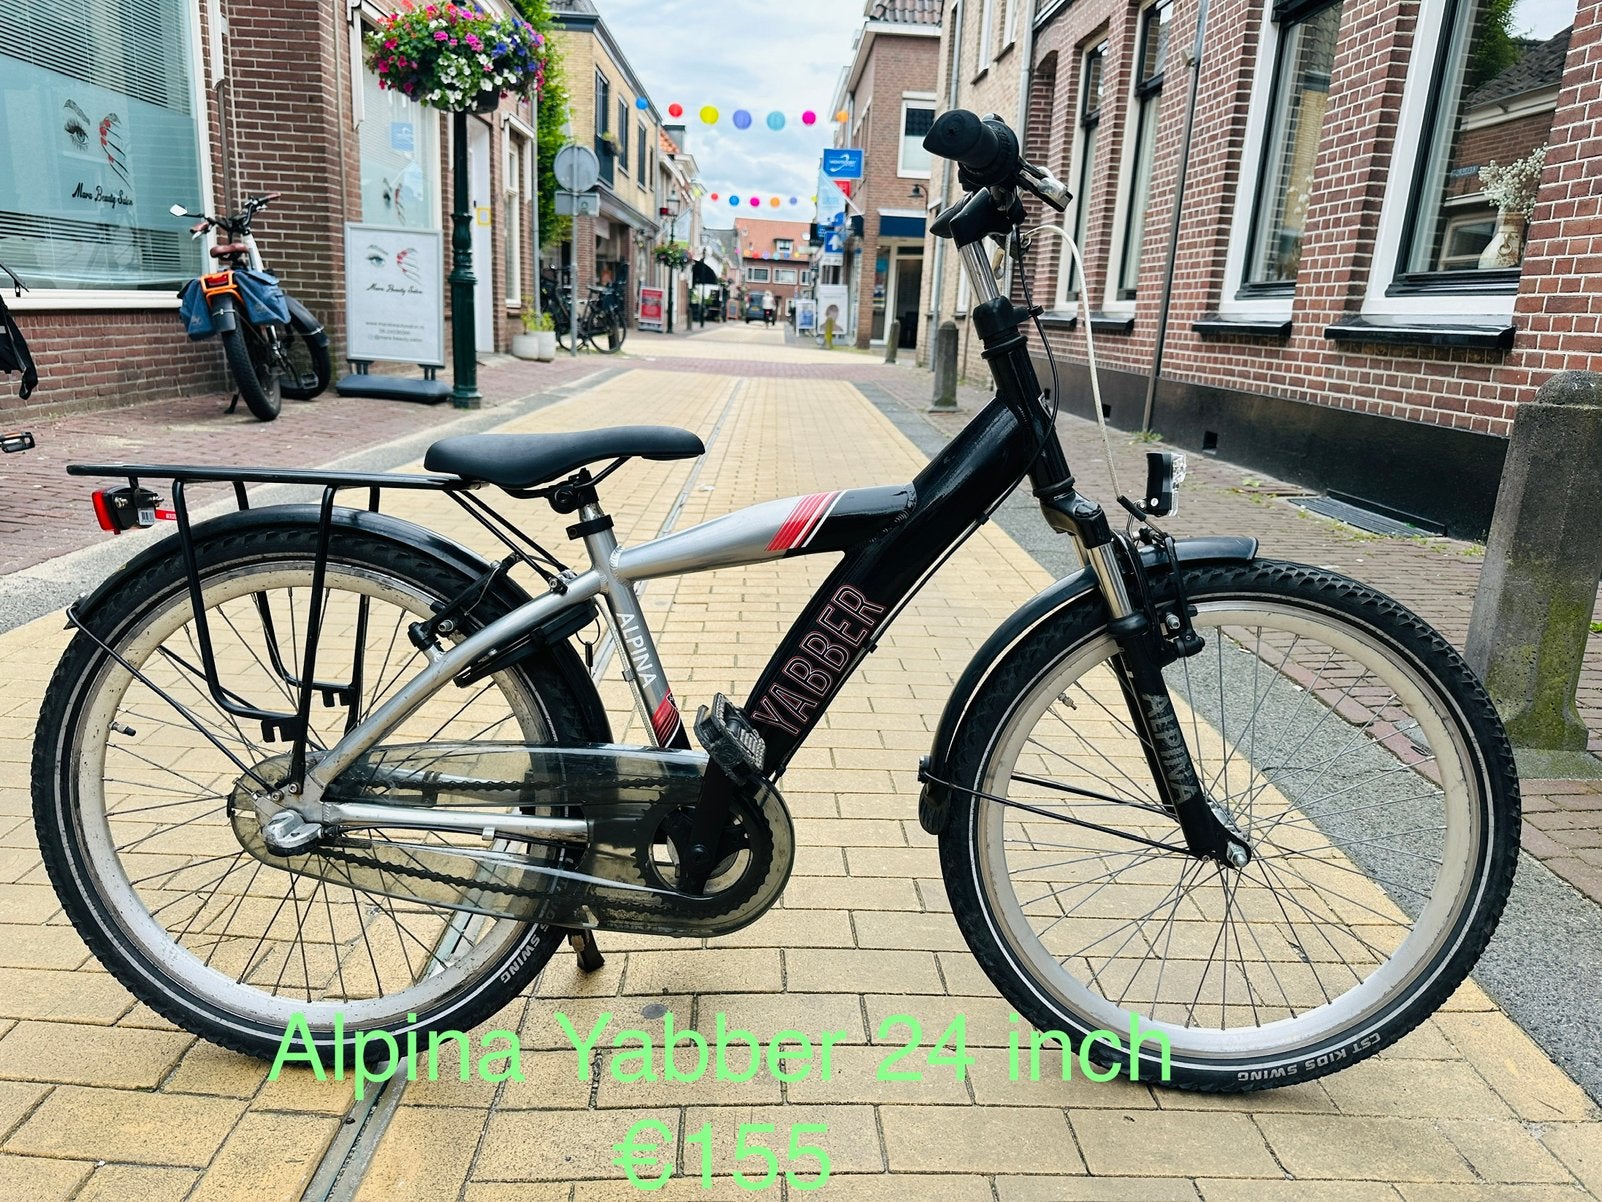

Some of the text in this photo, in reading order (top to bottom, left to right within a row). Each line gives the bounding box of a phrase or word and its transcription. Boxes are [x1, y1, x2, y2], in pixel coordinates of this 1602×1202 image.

[94, 185, 116, 209] Beauty
[616, 612, 658, 689] ALPINA
[751, 584, 887, 735] YABBER
[1140, 692, 1198, 805] ALPINA
[500, 934, 541, 984] SWING
[1237, 1032, 1381, 1082] CST KIDS SWING
